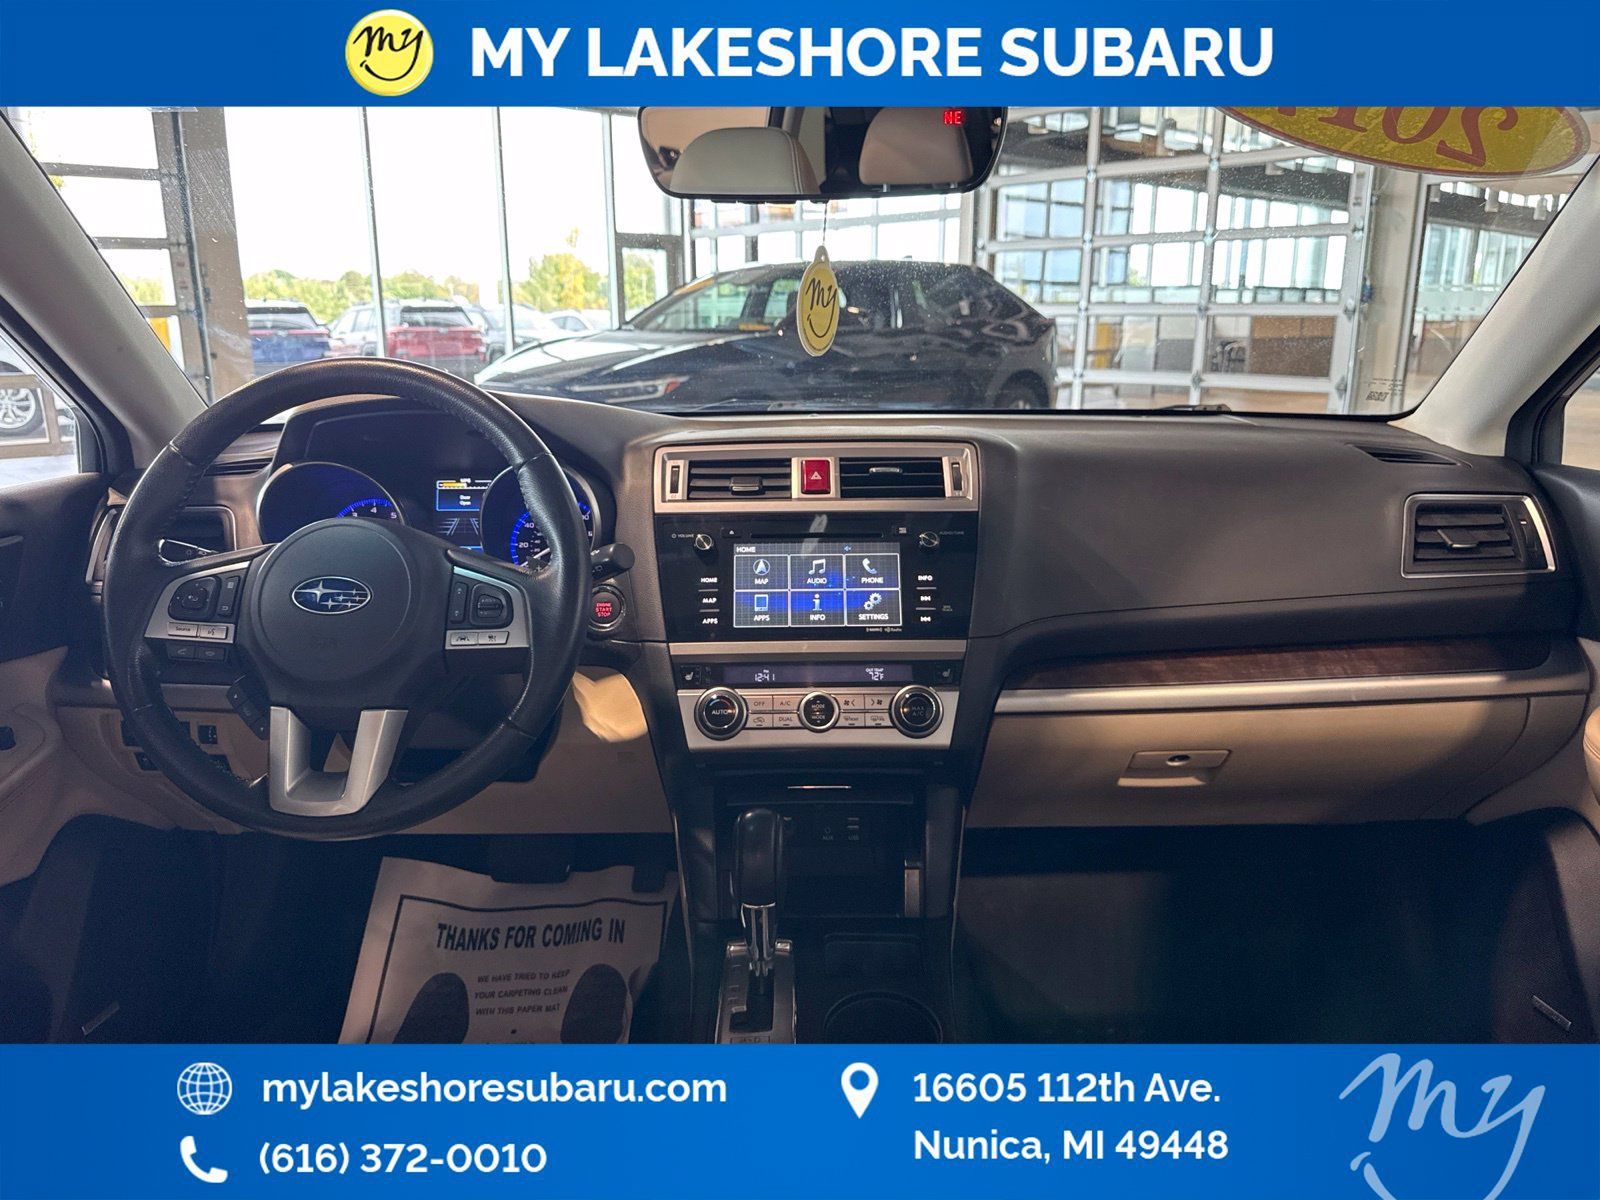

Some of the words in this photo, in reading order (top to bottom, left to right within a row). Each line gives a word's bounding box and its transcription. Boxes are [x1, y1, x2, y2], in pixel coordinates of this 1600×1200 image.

[944, 110, 962, 125] NE
[807, 577, 827, 585] AUDIO
[753, 614, 771, 622] APPS
[809, 613, 826, 621] INFO
[858, 613, 889, 621] SETTINGS
[755, 672, 775, 682] 12:41
[436, 923, 501, 952] THANKS
[504, 924, 536, 949] FOR
[542, 917, 602, 947] COMING
[608, 918, 625, 944] IN
[477, 975, 490, 983] WE
[491, 973, 512, 983] HAVE
[514, 972, 537, 982] TRIED
[539, 971, 550, 981] TO
[474, 991, 496, 1000] YOUR
[497, 988, 542, 999] CARPETING
[543, 986, 568, 997] CLEAN
[476, 1006, 495, 1016] WITH
[497, 1006, 515, 1016] THIS
[517, 1004, 543, 1014] PAPER
[545, 1003, 560, 1013] MAT
